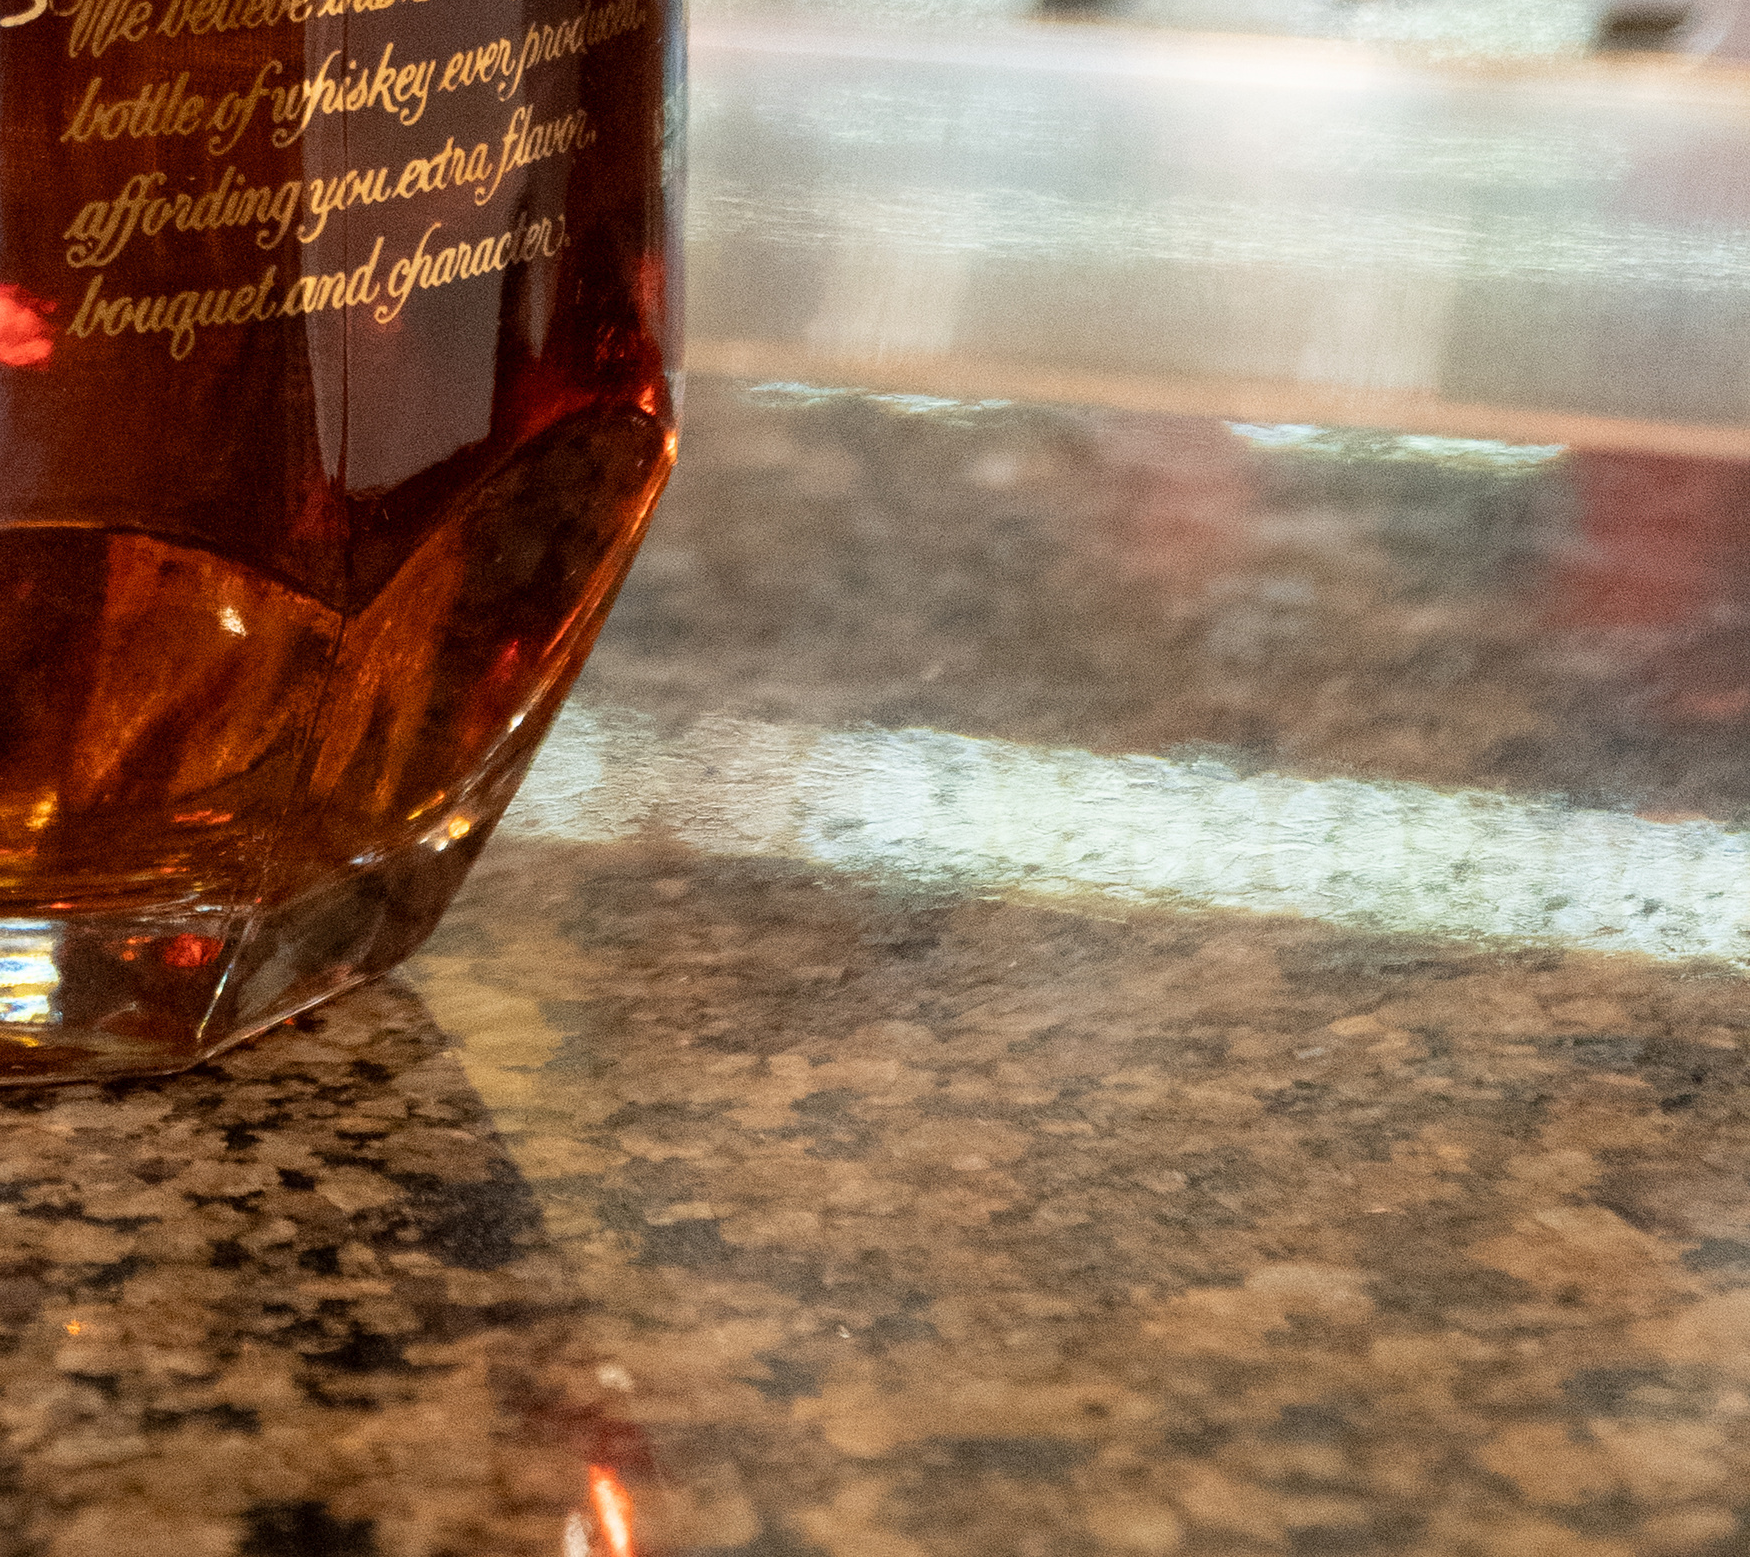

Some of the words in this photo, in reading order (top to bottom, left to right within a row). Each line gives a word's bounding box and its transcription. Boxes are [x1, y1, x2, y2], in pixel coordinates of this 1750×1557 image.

[60, 71, 205, 143] bottle
[205, 59, 284, 157] of
[271, 41, 436, 149] whiskey
[438, 36, 515, 93] ever
[62, 165, 301, 269] affording
[297, 167, 391, 244] you
[392, 136, 494, 200] extra
[65, 264, 277, 361] bouquet
[277, 236, 385, 317] and
